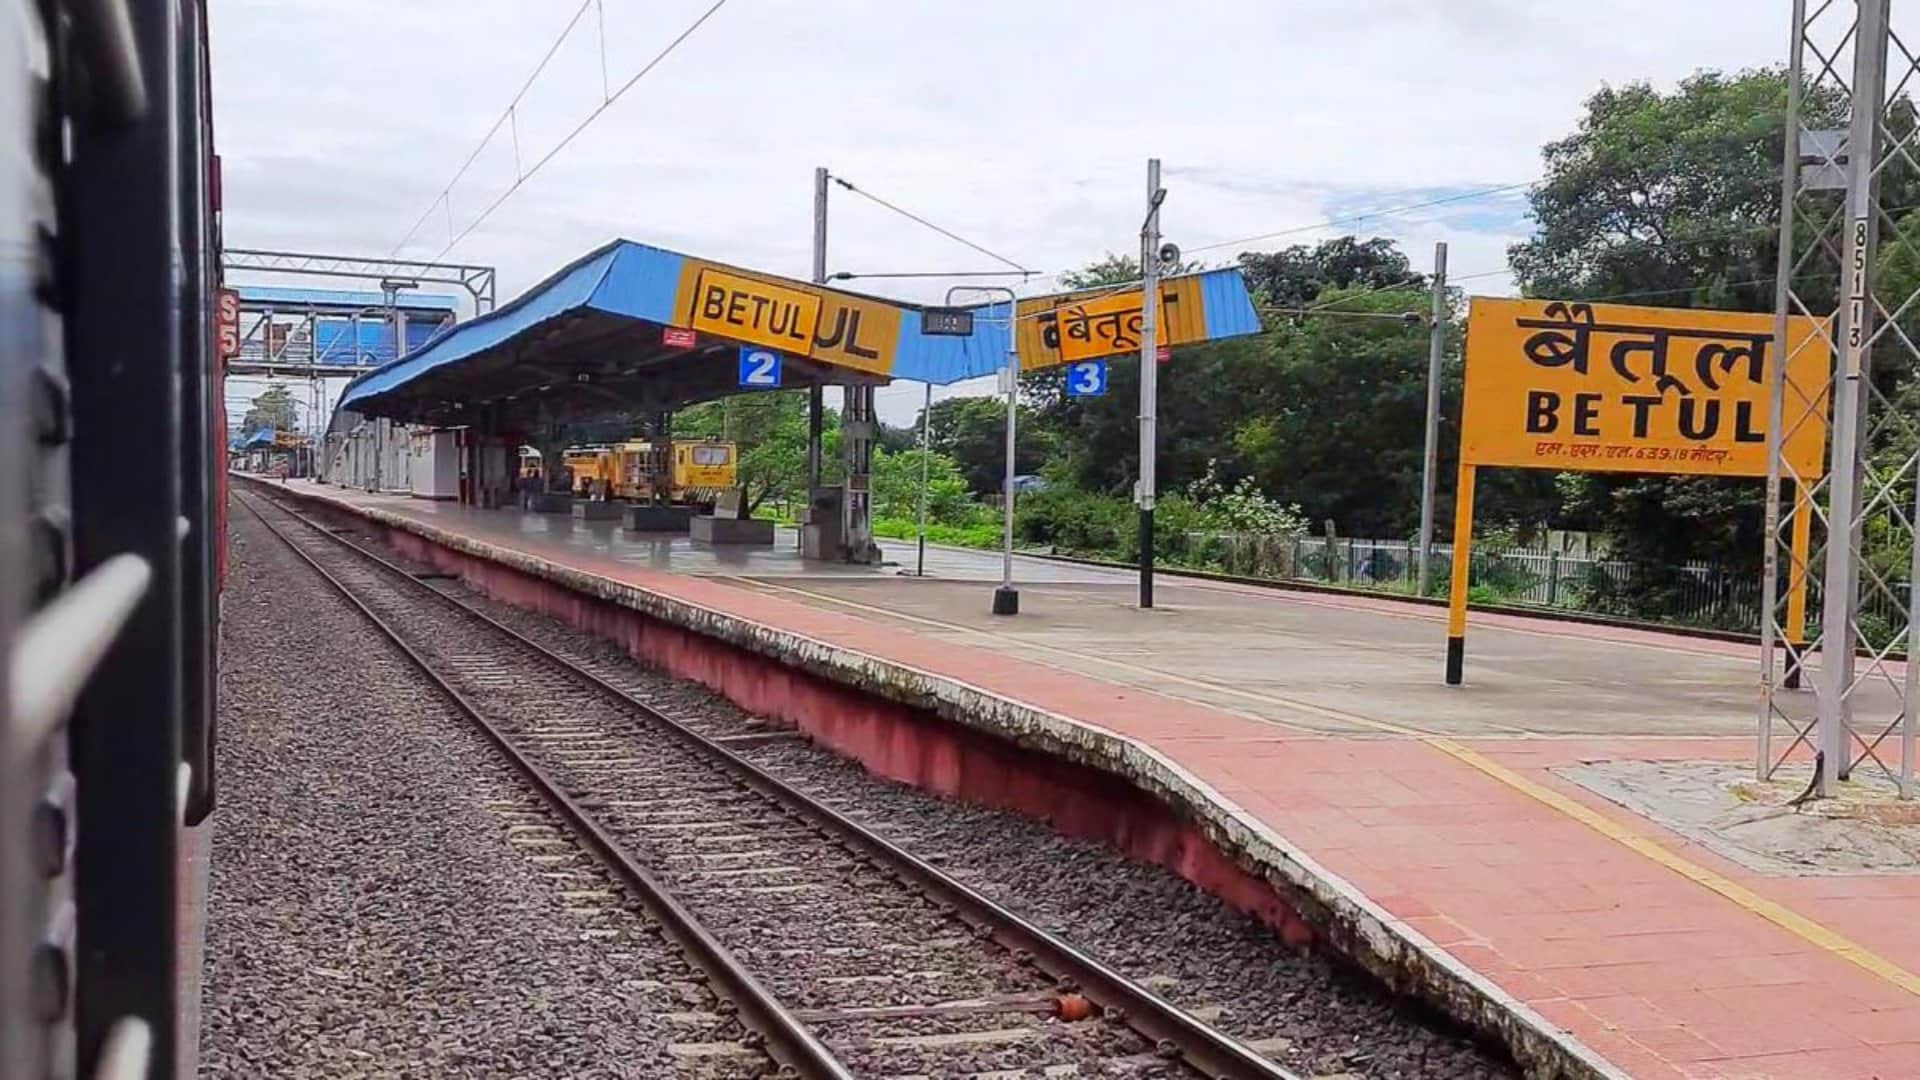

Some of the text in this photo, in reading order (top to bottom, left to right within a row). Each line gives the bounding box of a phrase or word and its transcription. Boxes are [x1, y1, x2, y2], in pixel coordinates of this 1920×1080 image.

[219, 294, 236, 353] S5
[703, 285, 805, 341] BETUL
[747, 351, 775, 384] 2
[1516, 302, 1774, 396] बैतूल
[1074, 362, 1101, 393] 3
[1526, 390, 1766, 443] BETUL
